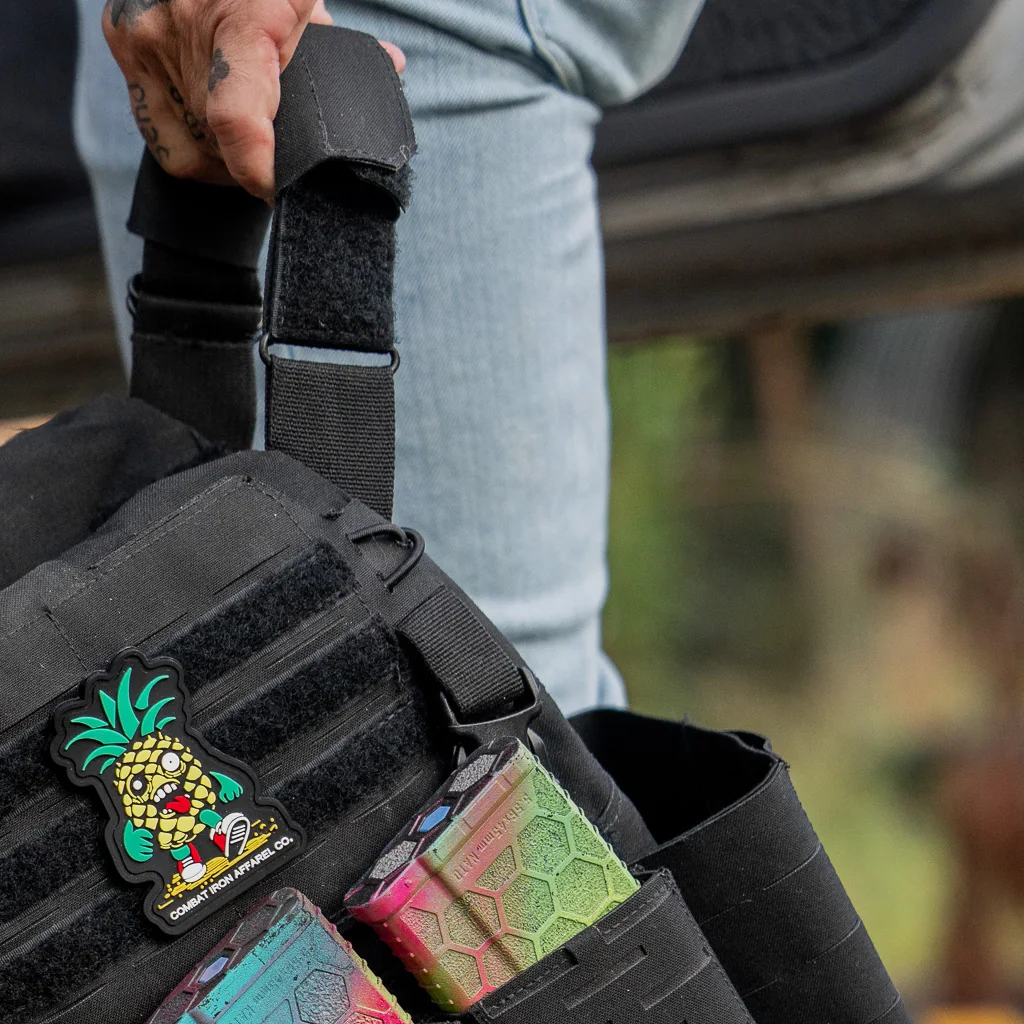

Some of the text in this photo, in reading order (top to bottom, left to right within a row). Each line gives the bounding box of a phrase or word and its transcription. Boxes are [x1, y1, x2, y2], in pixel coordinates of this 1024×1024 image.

[170, 890, 208, 920] COMBAT
[208, 874, 234, 895] IRON
[274, 836, 294, 851] CO.
[453, 850, 480, 882] NATO
